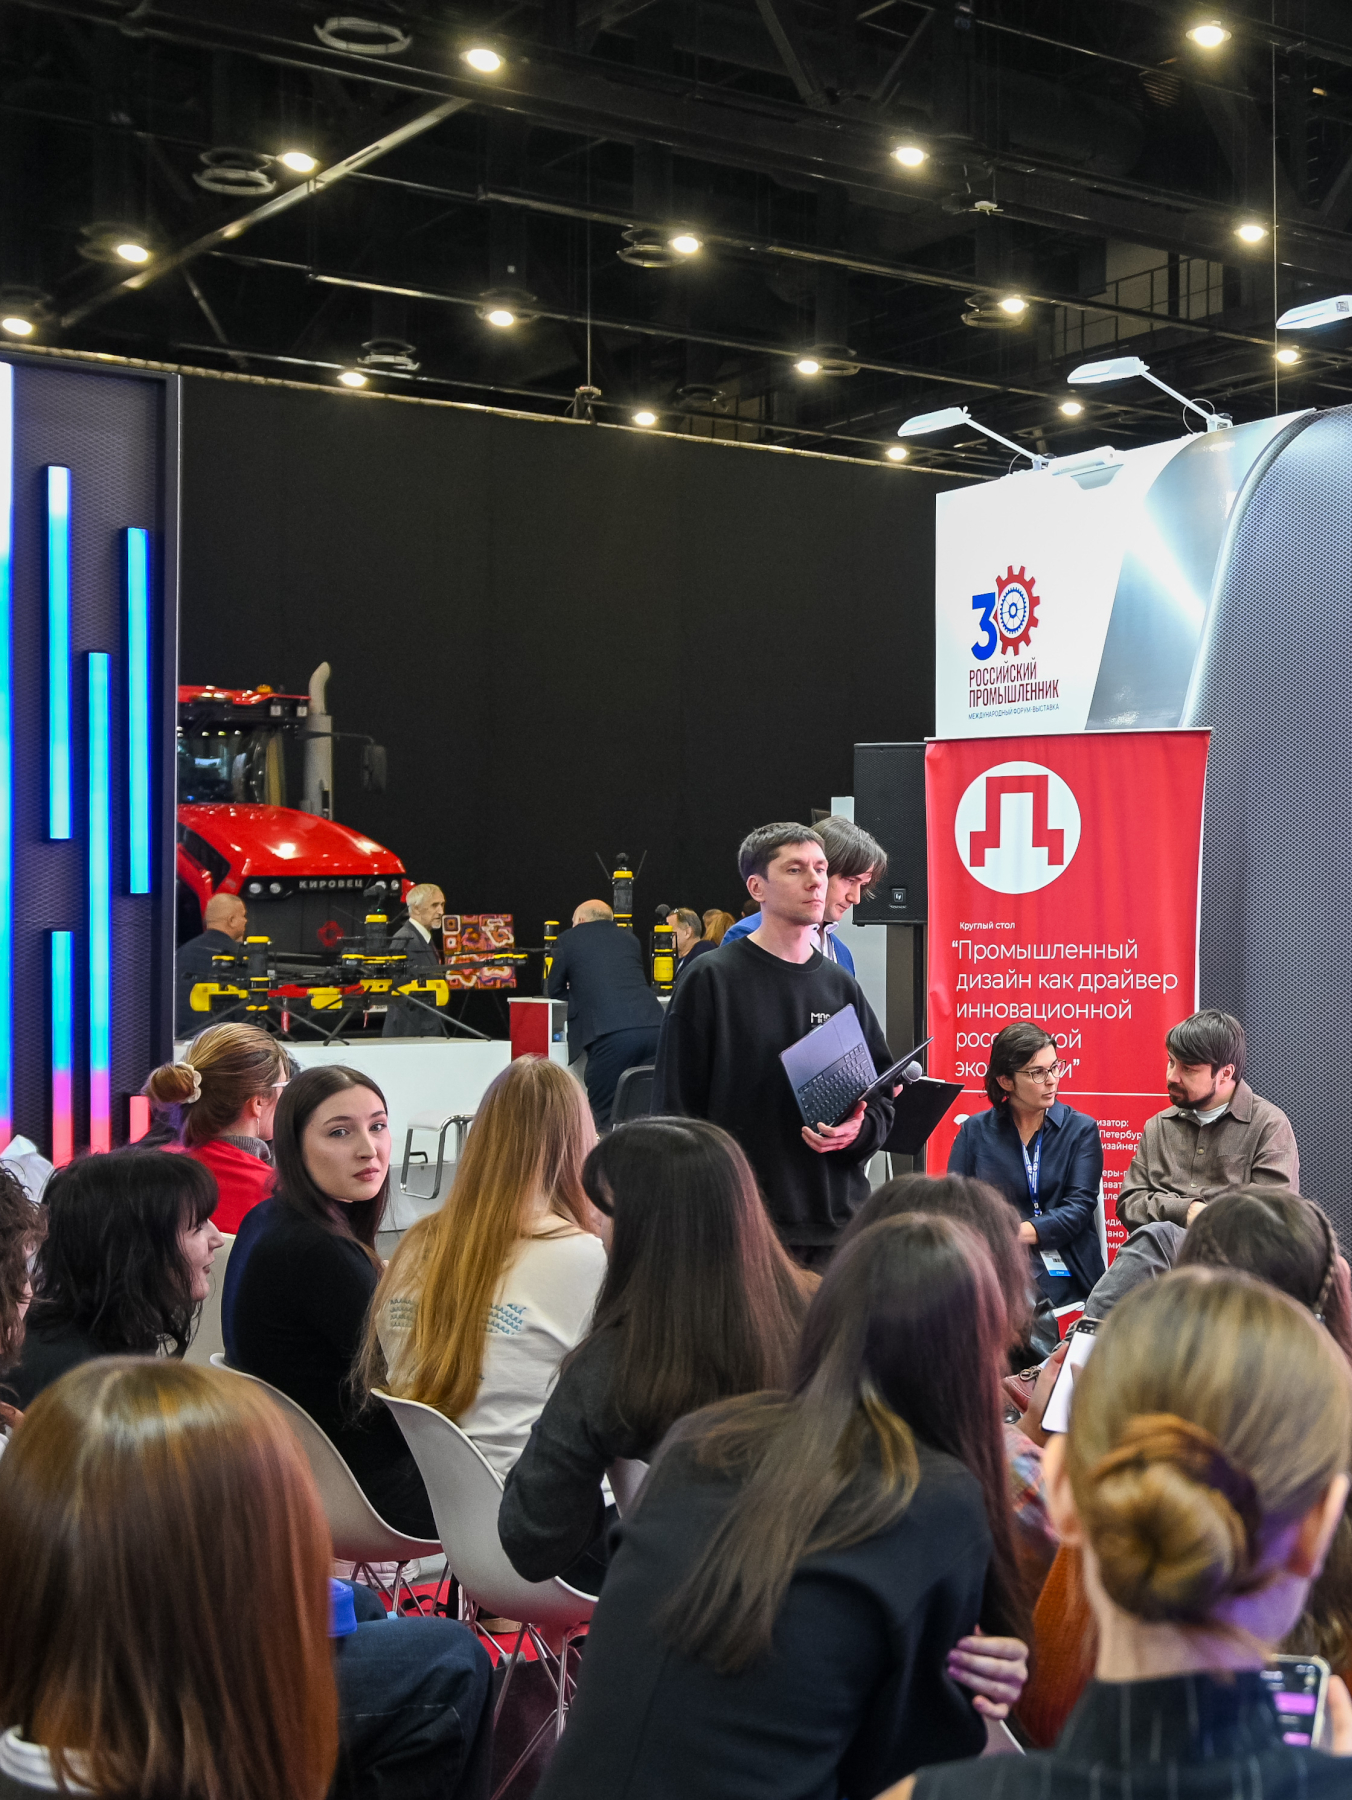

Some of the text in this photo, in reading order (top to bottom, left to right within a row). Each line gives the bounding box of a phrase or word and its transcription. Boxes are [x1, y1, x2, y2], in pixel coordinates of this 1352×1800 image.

[969, 657, 1037, 688] РОССИЙСКИЙ
[969, 679, 1059, 708] ПРОМЫШЛЕННИК
[968, 703, 1060, 720] МЕЖДУНАРОДНЫЙ ФОРУМ-ВЫСТАВКА
[299, 880, 363, 888] КИРОВЕЦ
[959, 921, 1015, 930] Круглый стол
[956, 969, 1178, 993] дизайн как драйвер
[957, 999, 1132, 1021] инновационной
[1096, 1119, 1129, 1129] изатор:
[1101, 1141, 1139, 1153] изайнер
